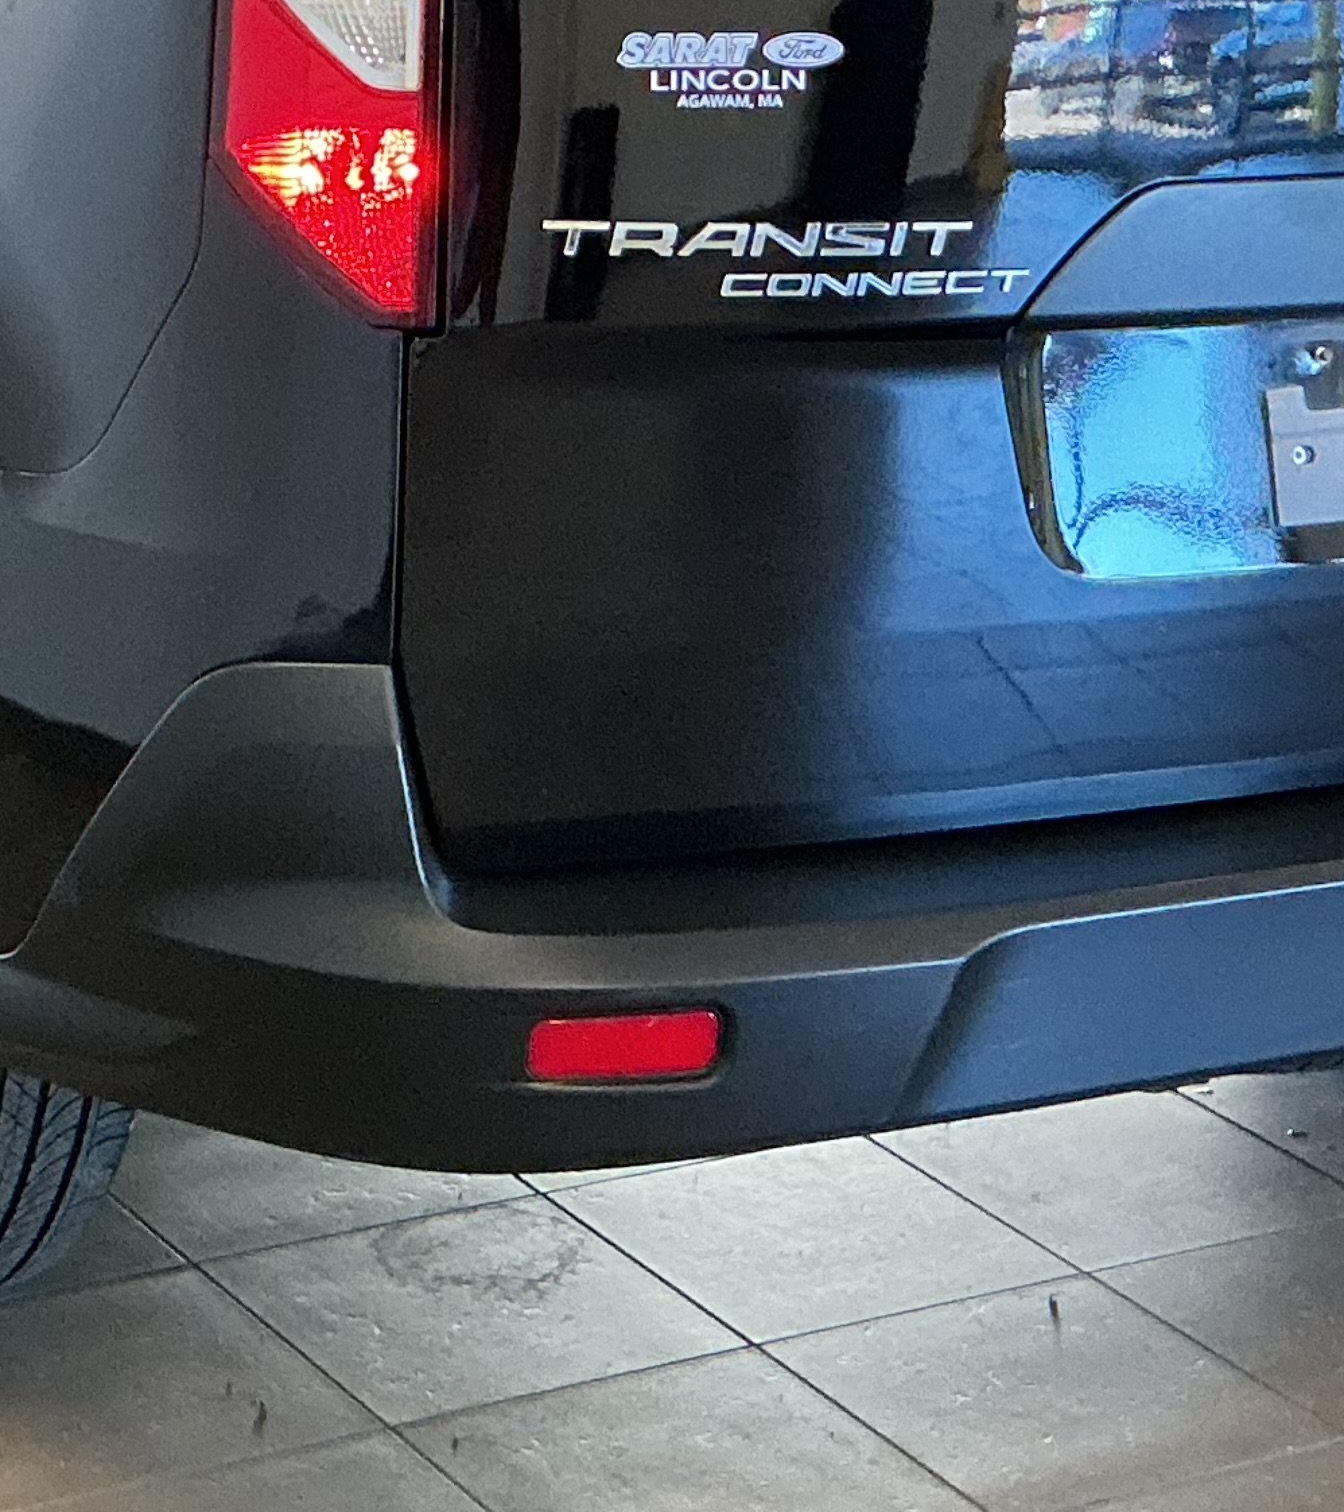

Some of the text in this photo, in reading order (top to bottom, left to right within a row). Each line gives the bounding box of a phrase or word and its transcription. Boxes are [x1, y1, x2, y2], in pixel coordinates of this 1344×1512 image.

[619, 33, 757, 66] SARAT
[649, 69, 806, 92] LINCOLN
[676, 93, 784, 110] AGAWAM, MA
[542, 219, 974, 257] TRANSIT
[719, 269, 1031, 298] CONNECT
